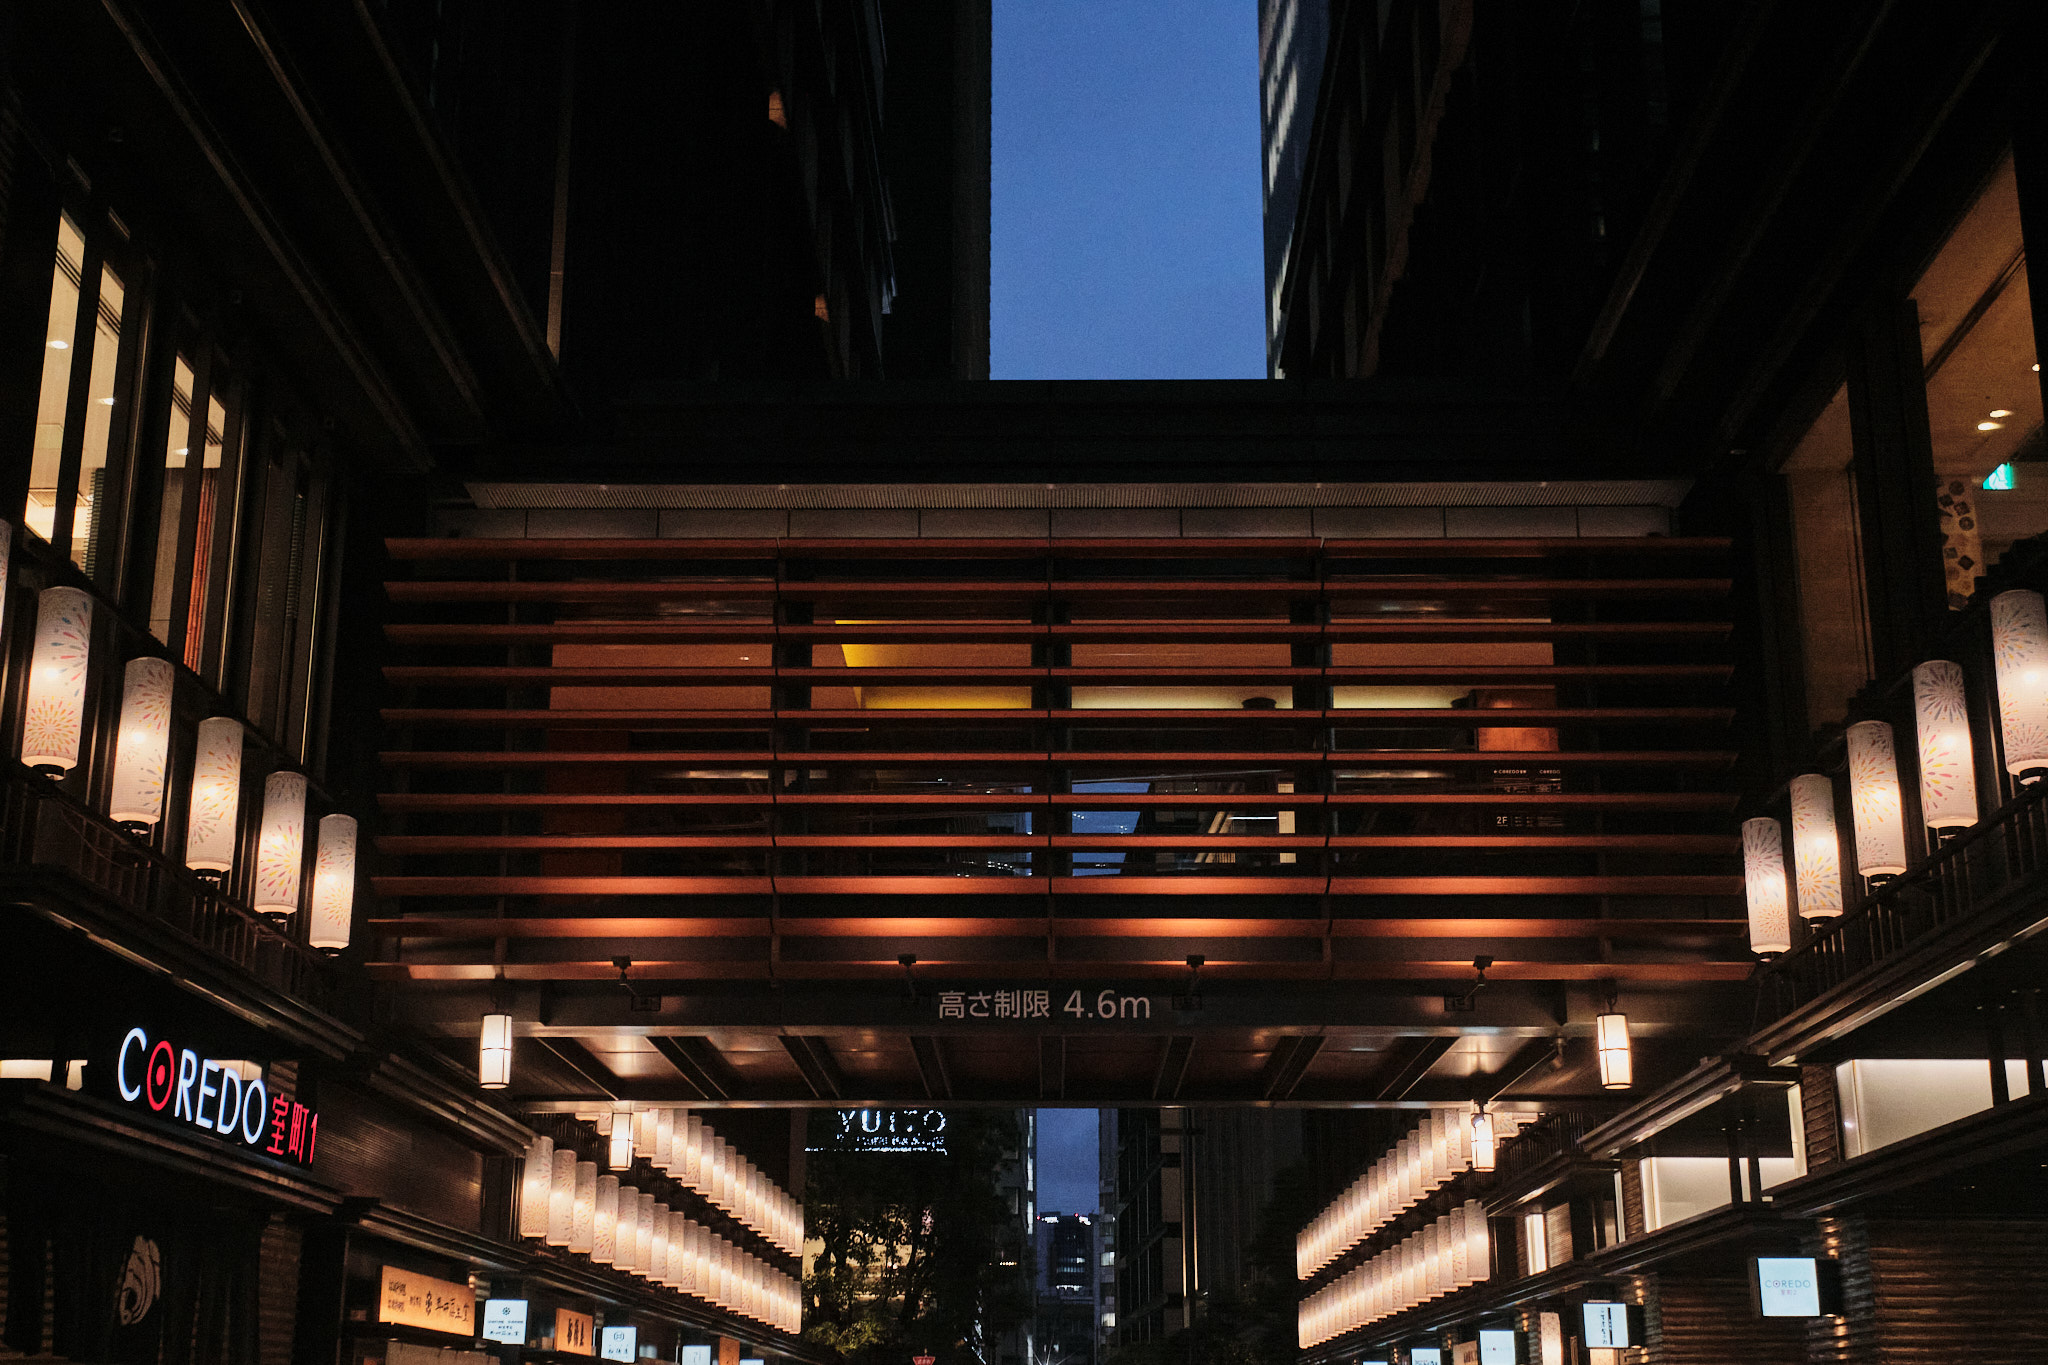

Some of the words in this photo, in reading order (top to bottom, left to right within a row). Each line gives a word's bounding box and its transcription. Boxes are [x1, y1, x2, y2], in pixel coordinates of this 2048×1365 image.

[1496, 816, 1508, 824] 2F
[938, 990, 1050, 1019] 高さ制限
[1063, 989, 1151, 1019] 4.6m
[118, 1027, 267, 1144] COREDO
[267, 1093, 319, 1164] 室町1
[1765, 1279, 1811, 1288] COREDO
